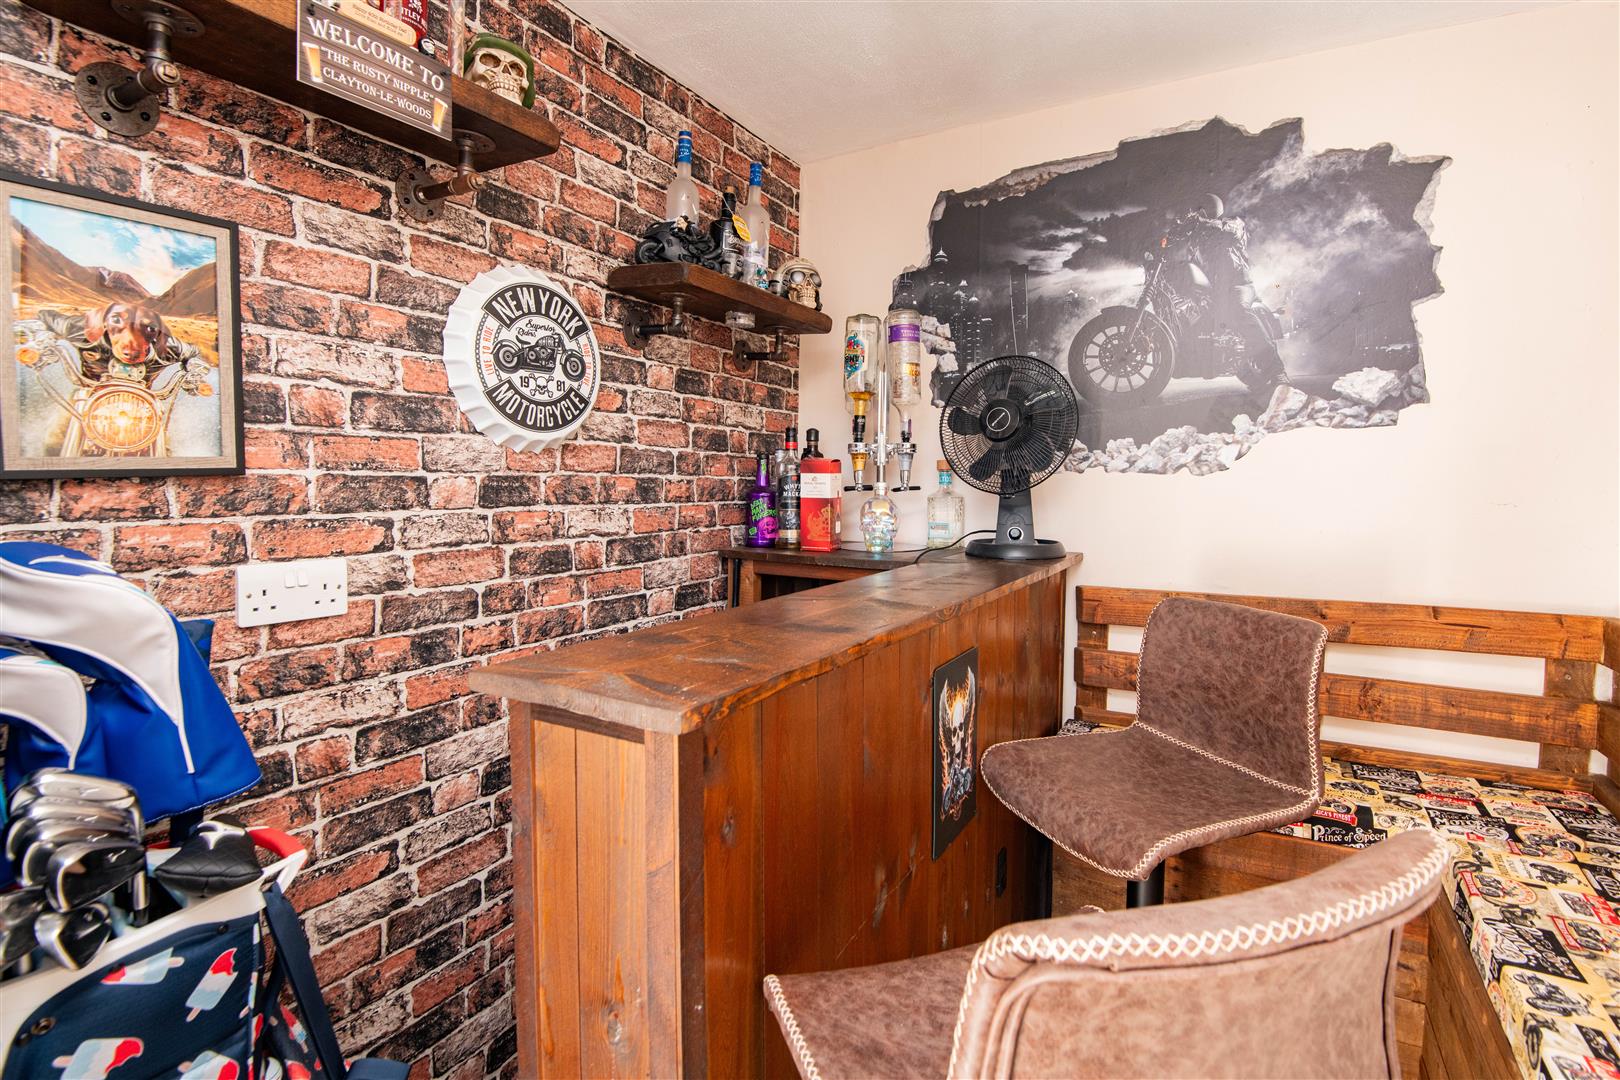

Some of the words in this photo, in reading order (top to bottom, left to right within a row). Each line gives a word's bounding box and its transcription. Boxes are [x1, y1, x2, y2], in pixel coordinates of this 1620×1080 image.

[307, 16, 415, 76] WELCOME
[419, 64, 444, 92] TO
[353, 60, 393, 84] RUSTY
[322, 66, 432, 119] CLAYTON-LE-WOODS
[492, 286, 536, 325] NEW
[539, 288, 583, 337] YORK
[483, 326, 494, 344] RIDE
[525, 318, 556, 333] Superior
[483, 345, 491, 354] TO
[483, 359, 495, 376] LIVE
[519, 375, 530, 388] 19
[556, 380, 566, 392] 81
[492, 381, 585, 427] MOTORCYCLE
[1312, 824, 1342, 842] Prince
[1343, 833, 1354, 843] of
[1354, 827, 1387, 843] Speed
